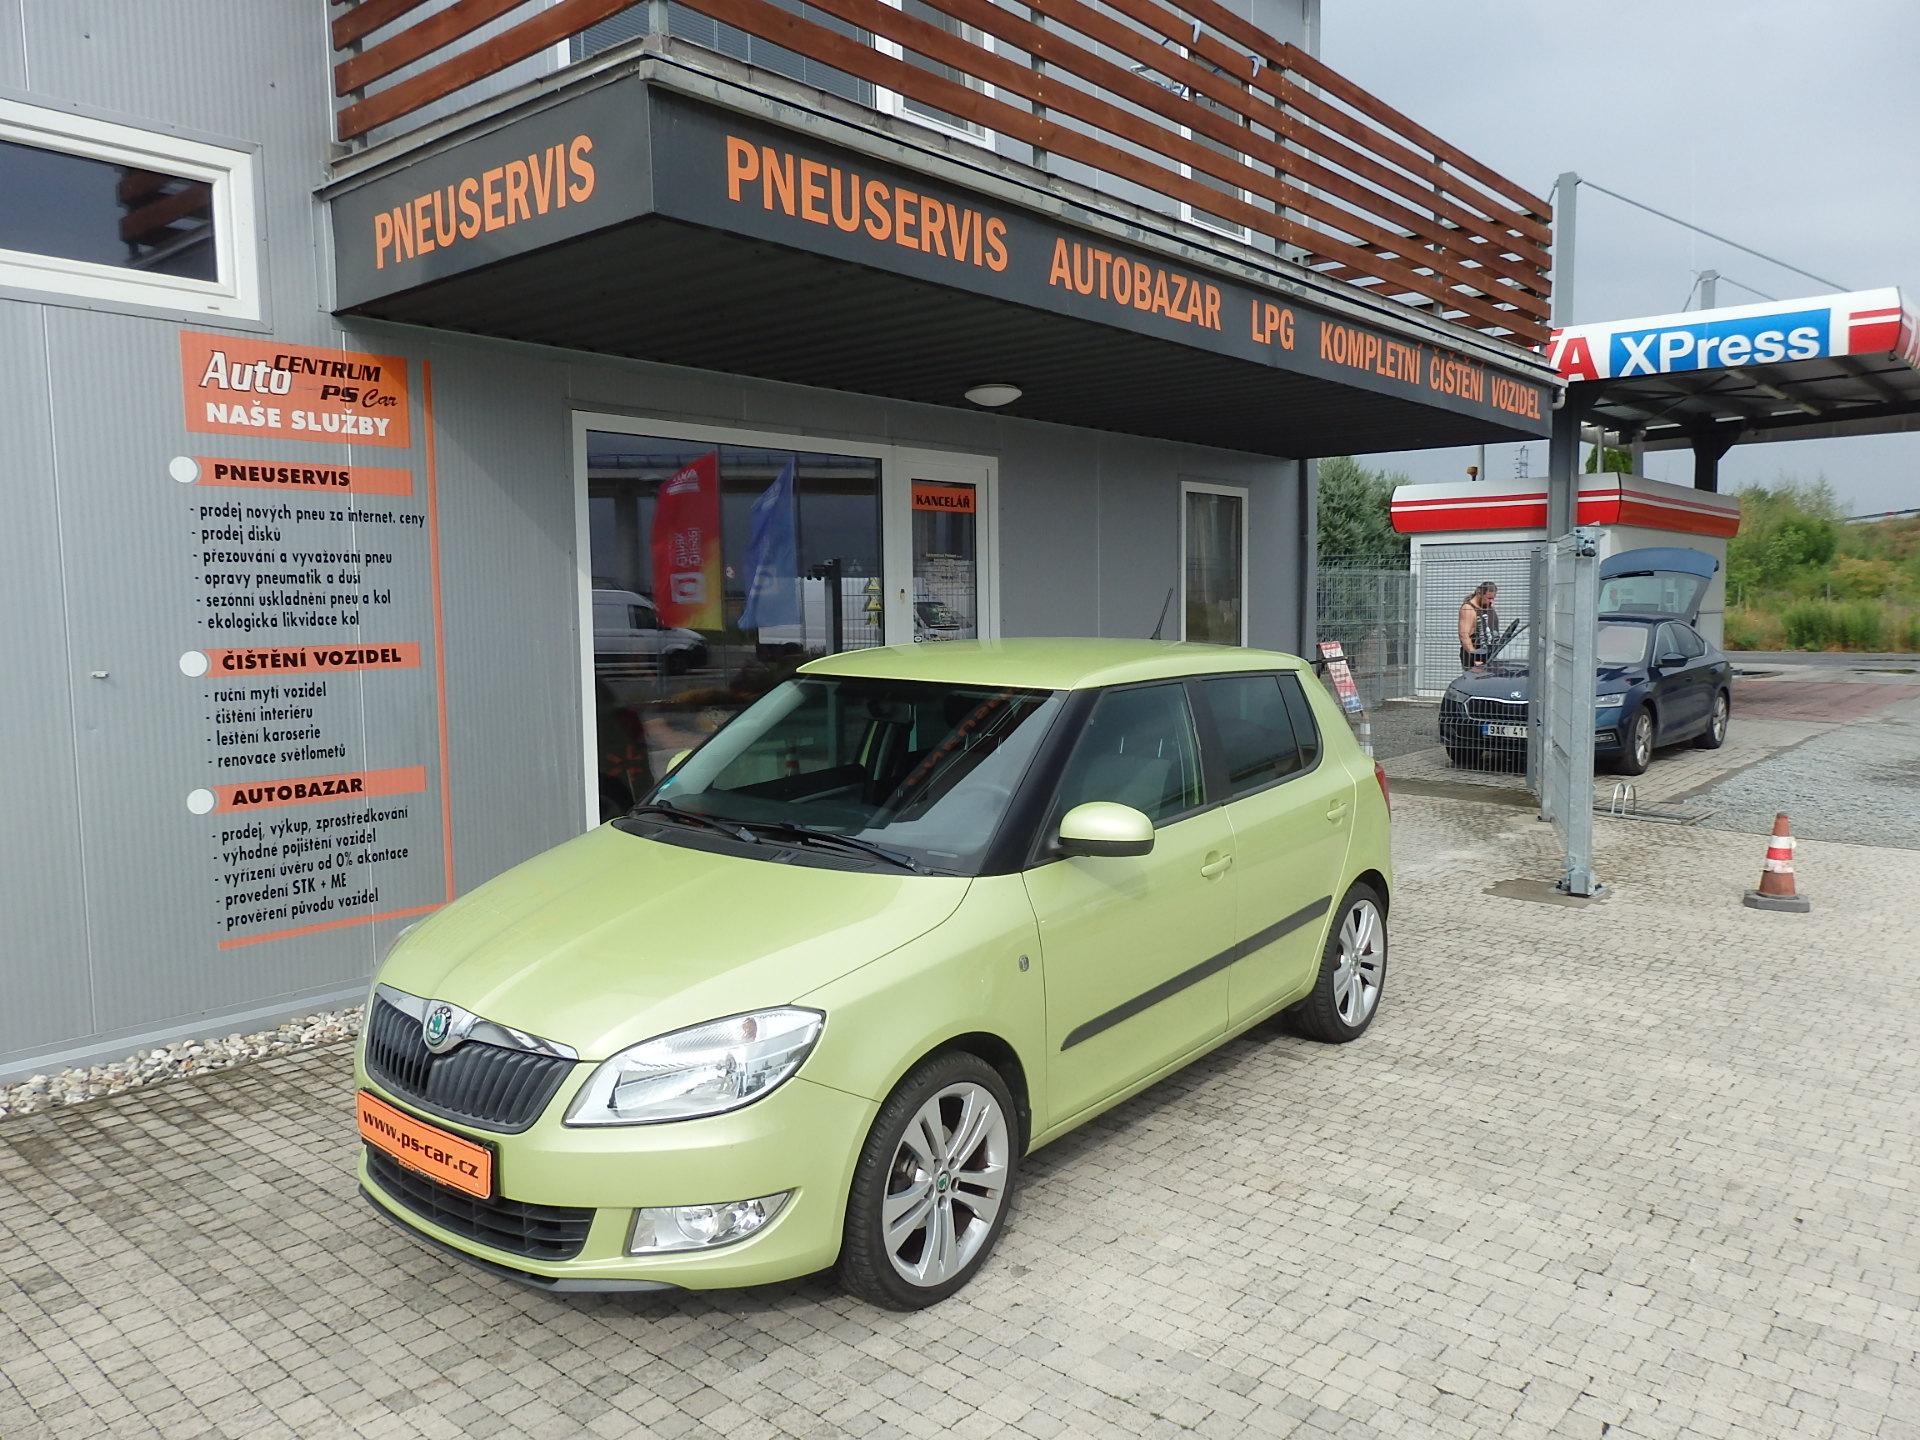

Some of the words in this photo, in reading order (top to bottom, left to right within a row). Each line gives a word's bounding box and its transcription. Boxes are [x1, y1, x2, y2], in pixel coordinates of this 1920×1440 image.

[373, 133, 597, 270] PNEUSERVIS
[725, 133, 1009, 273] PNEUSERVIS
[1048, 237, 1222, 333] AUTOBAZAR
[1251, 299, 1295, 351] LPG
[1319, 320, 1424, 385] KOMPLETNÍ
[1429, 346, 1485, 403] ČIŠTĚNÍ
[1491, 375, 1541, 420] VOZIDEL
[1618, 325, 1821, 378] XPress
[198, 349, 293, 396] Auto
[274, 354, 382, 383] CENTRUM
[320, 384, 360, 403] PS
[361, 388, 399, 408] Car
[205, 399, 282, 429] NAŠE
[291, 408, 391, 437] SLUŽBY
[213, 463, 351, 488] PNEUSERVIS
[915, 493, 970, 508] KANCELÁŘ
[200, 501, 242, 522] prodej
[246, 503, 292, 523] nových
[296, 509, 326, 524] pneu
[329, 510, 344, 522] za
[347, 506, 396, 524] internet.
[399, 513, 426, 529] ceny
[201, 523, 244, 545] prodej
[203, 548, 275, 567] přezouvání
[279, 552, 287, 563] a
[292, 548, 361, 568] vyvažování
[365, 553, 392, 568] pneu
[204, 573, 251, 589] opravy
[256, 568, 322, 589] pneumatik
[326, 573, 334, 584] a
[259, 589, 326, 607] uskladnění
[330, 594, 358, 609] pneu
[362, 594, 370, 605] a
[373, 588, 391, 605] kol
[207, 611, 278, 633] ekologická
[282, 610, 338, 628] likvidace
[341, 609, 360, 627] kol
[222, 647, 307, 671] ČIŠTĚNÍ
[313, 648, 402, 667] VOZIDEL
[214, 686, 246, 703] ruční
[283, 681, 327, 699] vozidel
[215, 707, 256, 724] čištění
[260, 704, 313, 722] interiéru
[216, 729, 259, 746] leštění
[263, 724, 321, 743] karoserie
[218, 752, 276, 768] renovace
[281, 743, 346, 763] světlometů
[232, 778, 364, 806] AUTOBAZAR
[270, 817, 312, 839] výkup,
[316, 805, 408, 833] zprostředkování
[223, 842, 278, 867] výhodné
[282, 834, 332, 859] pojištění
[336, 827, 376, 848] vozidel
[224, 864, 276, 888] vyřízení
[280, 861, 314, 877] úvěru
[317, 853, 332, 871] od
[336, 851, 353, 868] 0%
[357, 847, 409, 865] akontace
[225, 883, 289, 911] provedení
[292, 877, 316, 896] STK
[331, 872, 347, 889] ME
[226, 903, 287, 932] prověření
[291, 895, 334, 920] původu
[338, 887, 379, 908] vozidel
[363, 1110, 479, 1179] www.ps-car.cz
